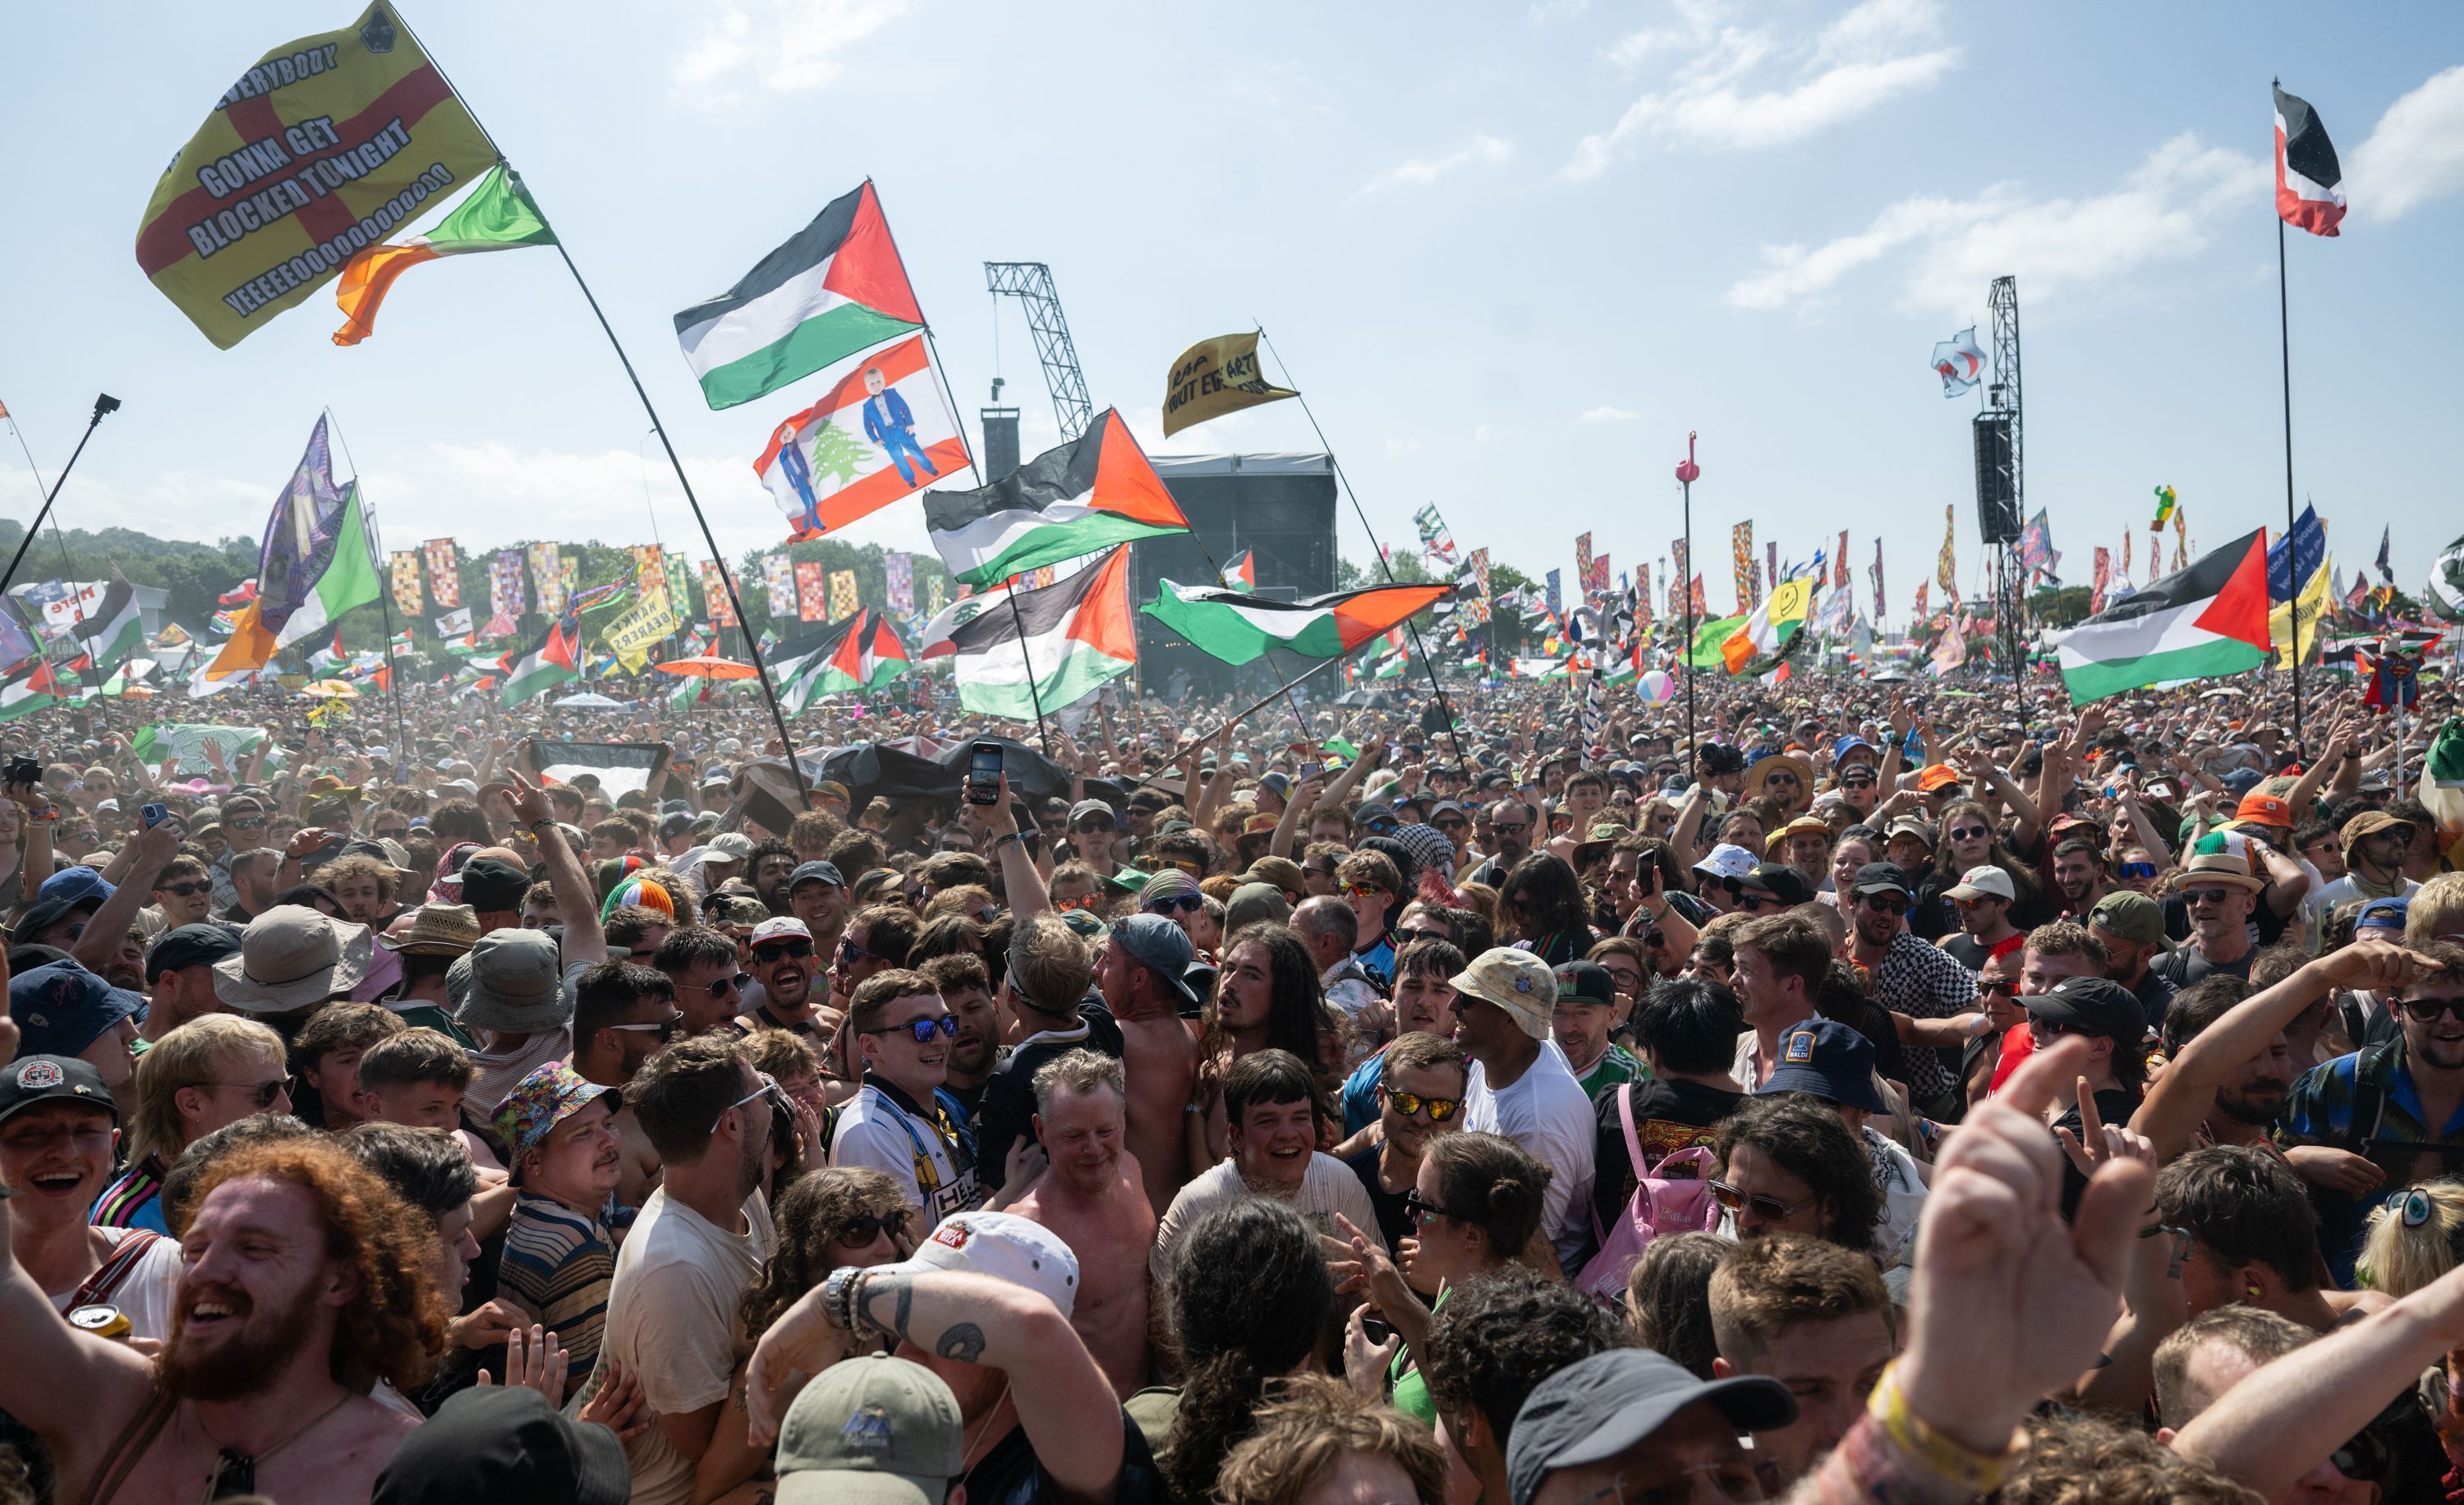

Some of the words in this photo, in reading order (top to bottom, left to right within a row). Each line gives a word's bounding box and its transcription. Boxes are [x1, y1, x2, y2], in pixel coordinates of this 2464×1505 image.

[186, 178, 312, 260] BLOCKED
[297, 116, 411, 197] TONIGHT
[197, 136, 293, 200] GONNA
[283, 115, 341, 156] GET
[1168, 379, 1198, 413] NOT
[1172, 355, 1208, 389] RAP
[1227, 351, 1255, 379] ART
